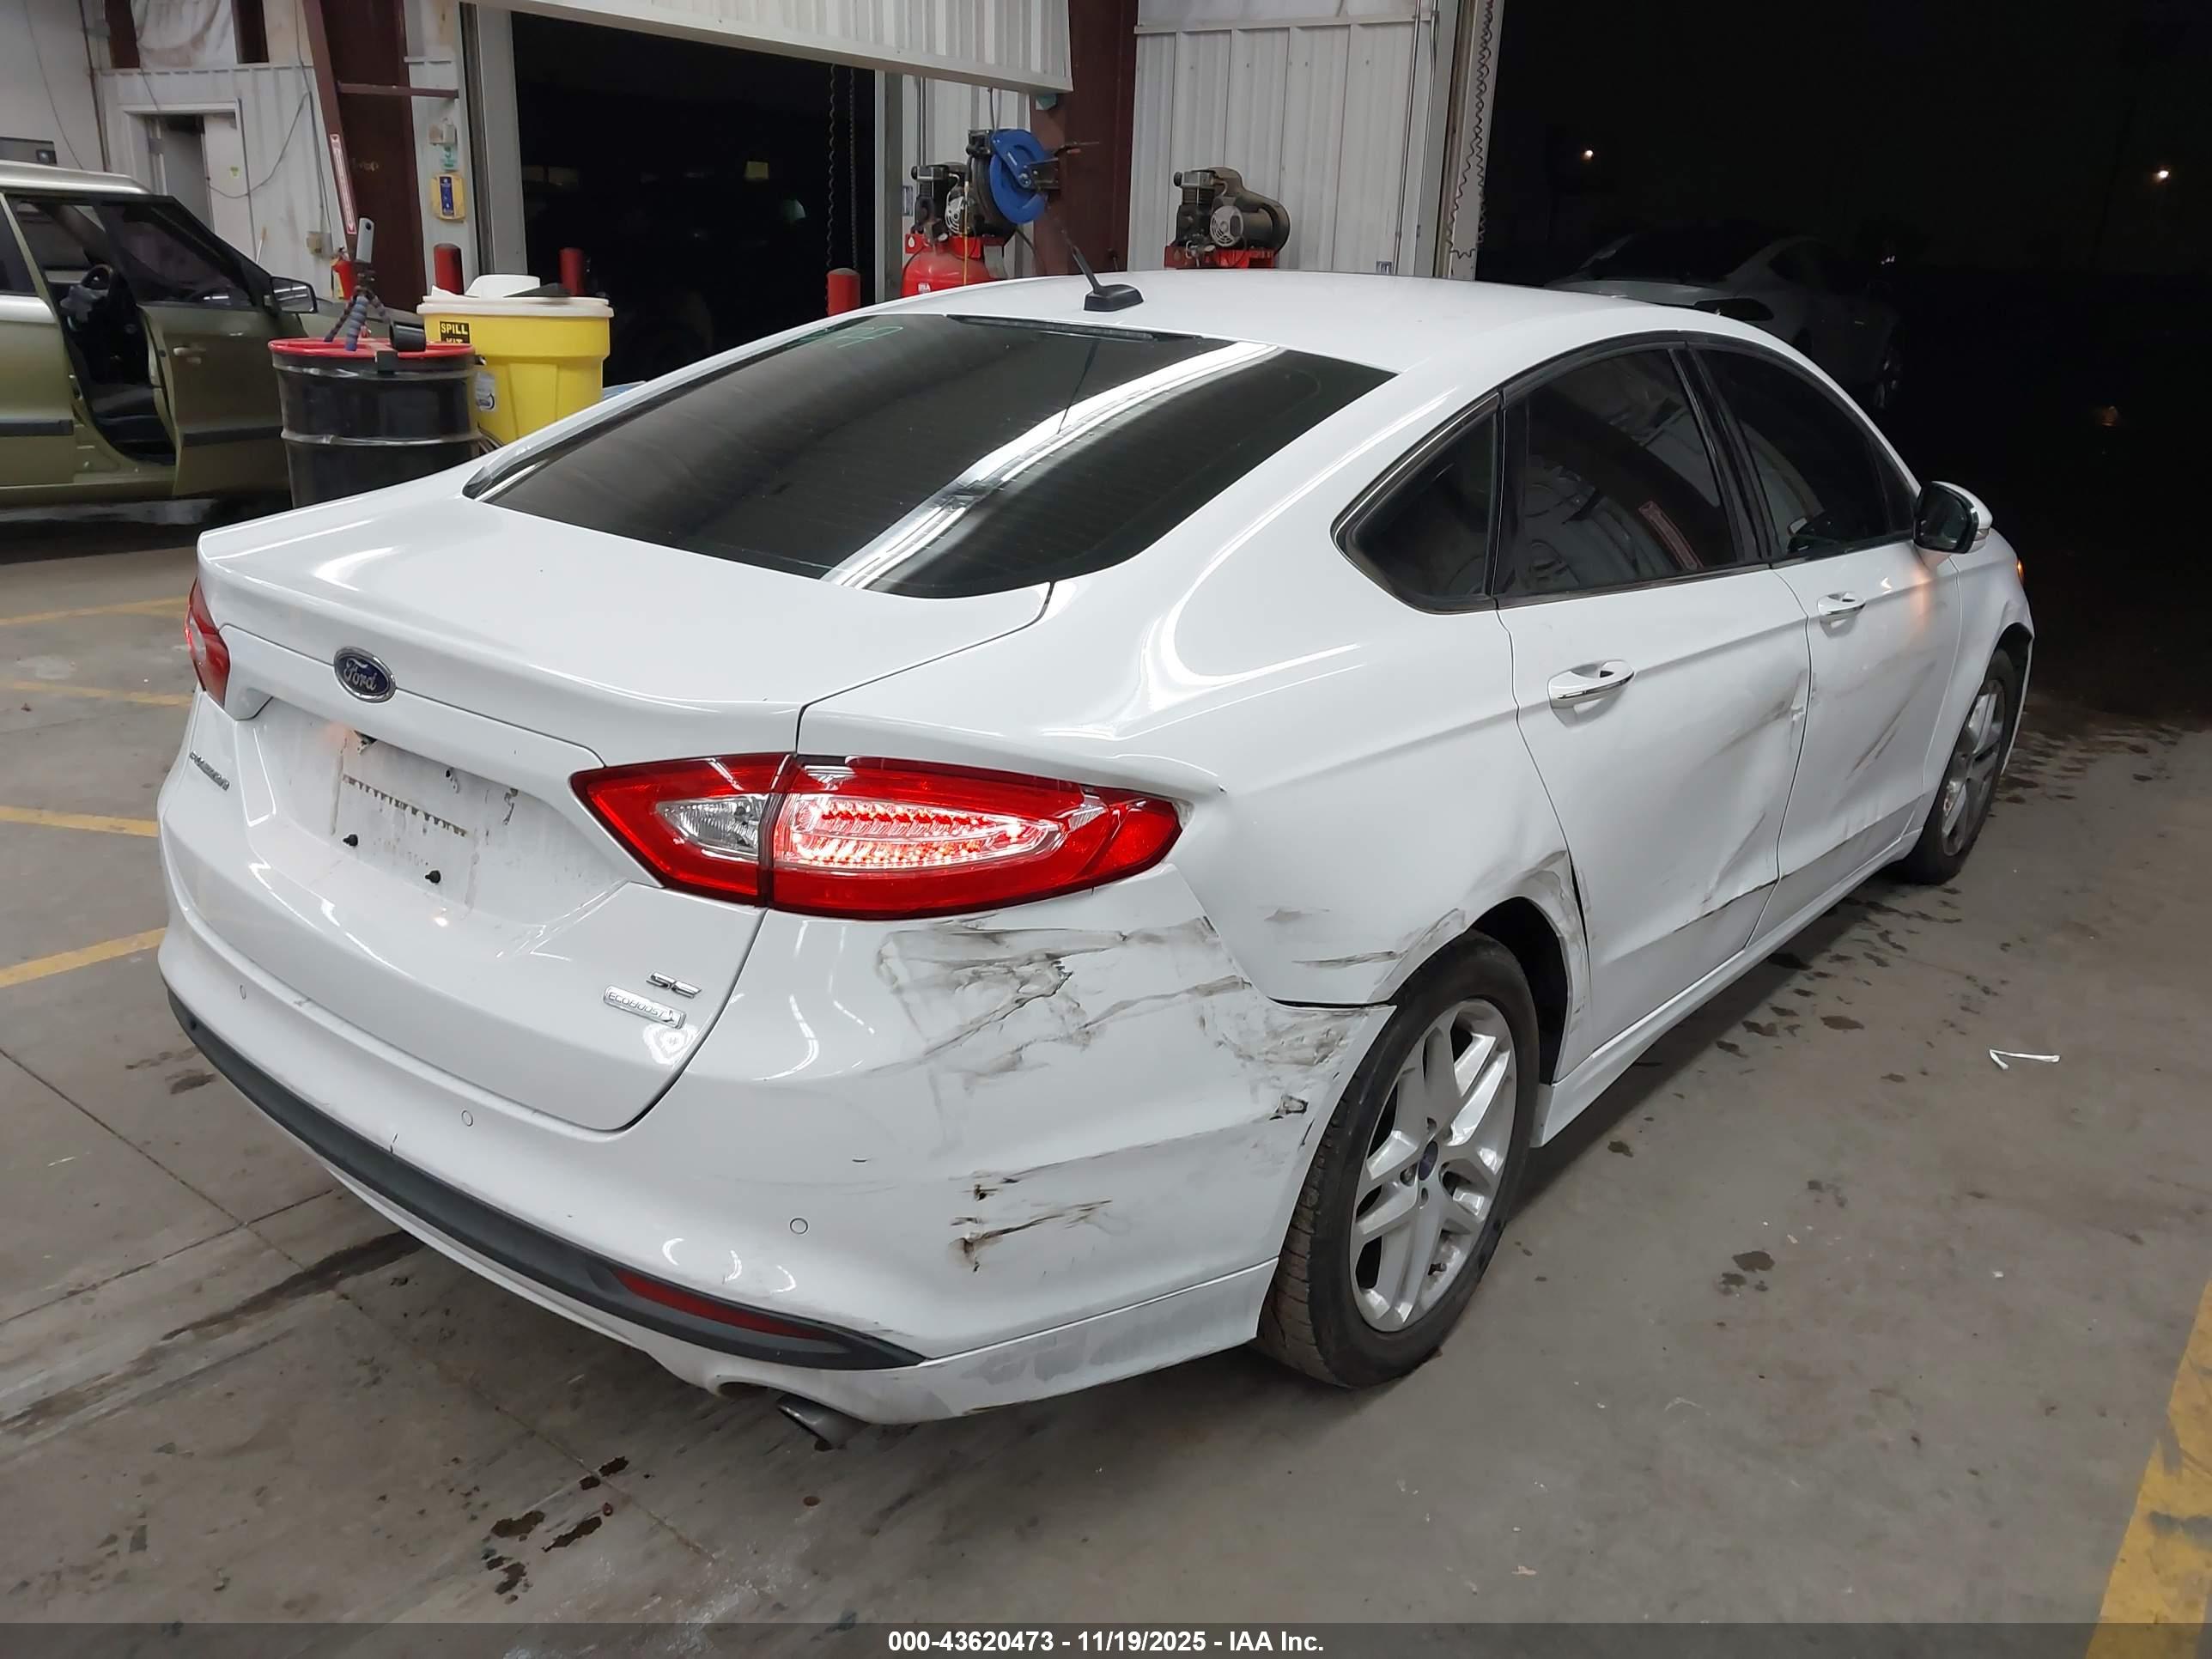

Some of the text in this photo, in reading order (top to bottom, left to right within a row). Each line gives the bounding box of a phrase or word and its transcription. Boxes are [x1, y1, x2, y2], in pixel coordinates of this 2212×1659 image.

[441, 323, 469, 335] SPILL
[343, 658, 377, 690] Ford
[646, 972, 702, 999] SE
[608, 992, 665, 1018] ECOBOOST
